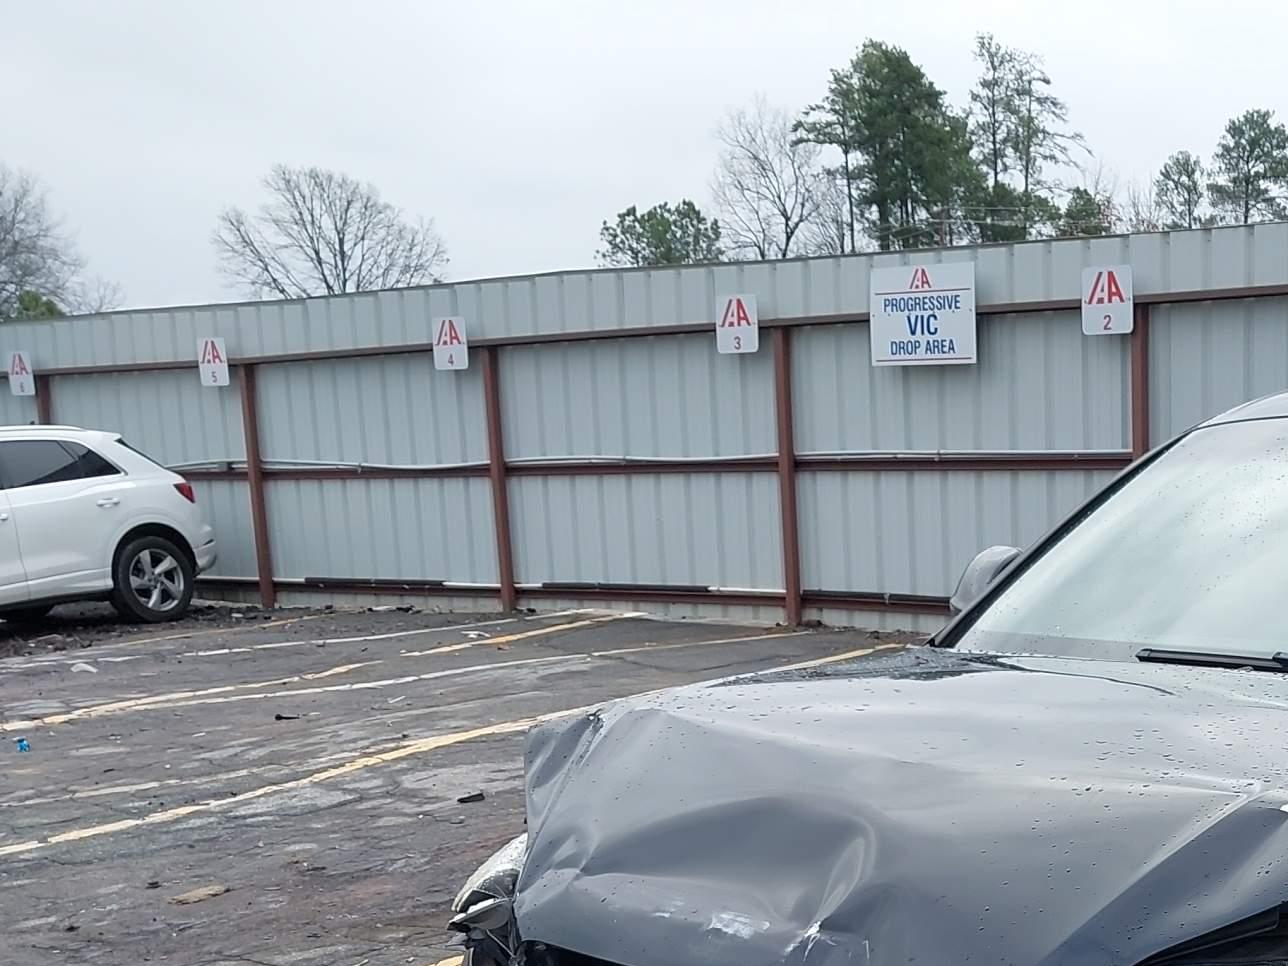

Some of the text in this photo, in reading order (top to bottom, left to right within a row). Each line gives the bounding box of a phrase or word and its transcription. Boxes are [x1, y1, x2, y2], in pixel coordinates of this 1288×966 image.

[883, 295, 961, 312] PROGRESSIVE
[906, 314, 938, 336] VIC
[1103, 314, 1112, 330] 2
[733, 336, 742, 350] 3
[890, 339, 956, 355] DROP AREA
[447, 353, 454, 366] 4
[211, 371, 218, 383] 5
